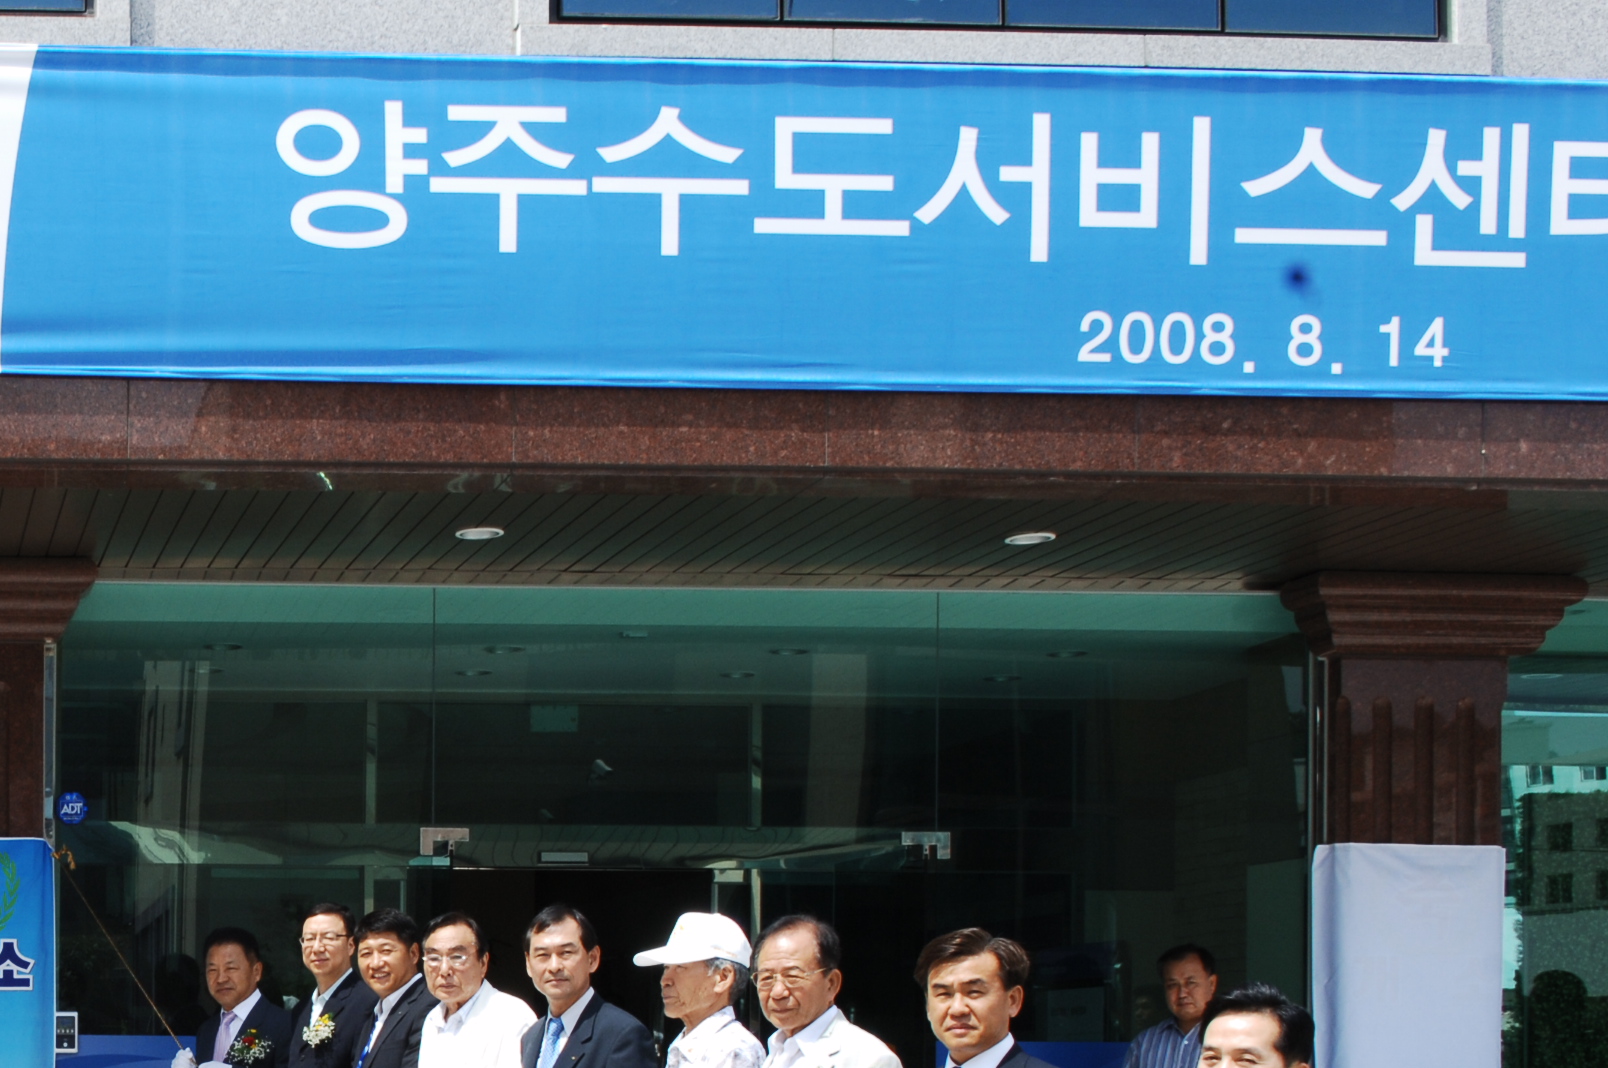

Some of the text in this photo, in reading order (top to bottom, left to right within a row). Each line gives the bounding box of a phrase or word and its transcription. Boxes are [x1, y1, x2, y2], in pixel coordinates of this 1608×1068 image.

[1077, 310, 1449, 375] 2008. 8. 14
[60, 802, 83, 814] ADT
